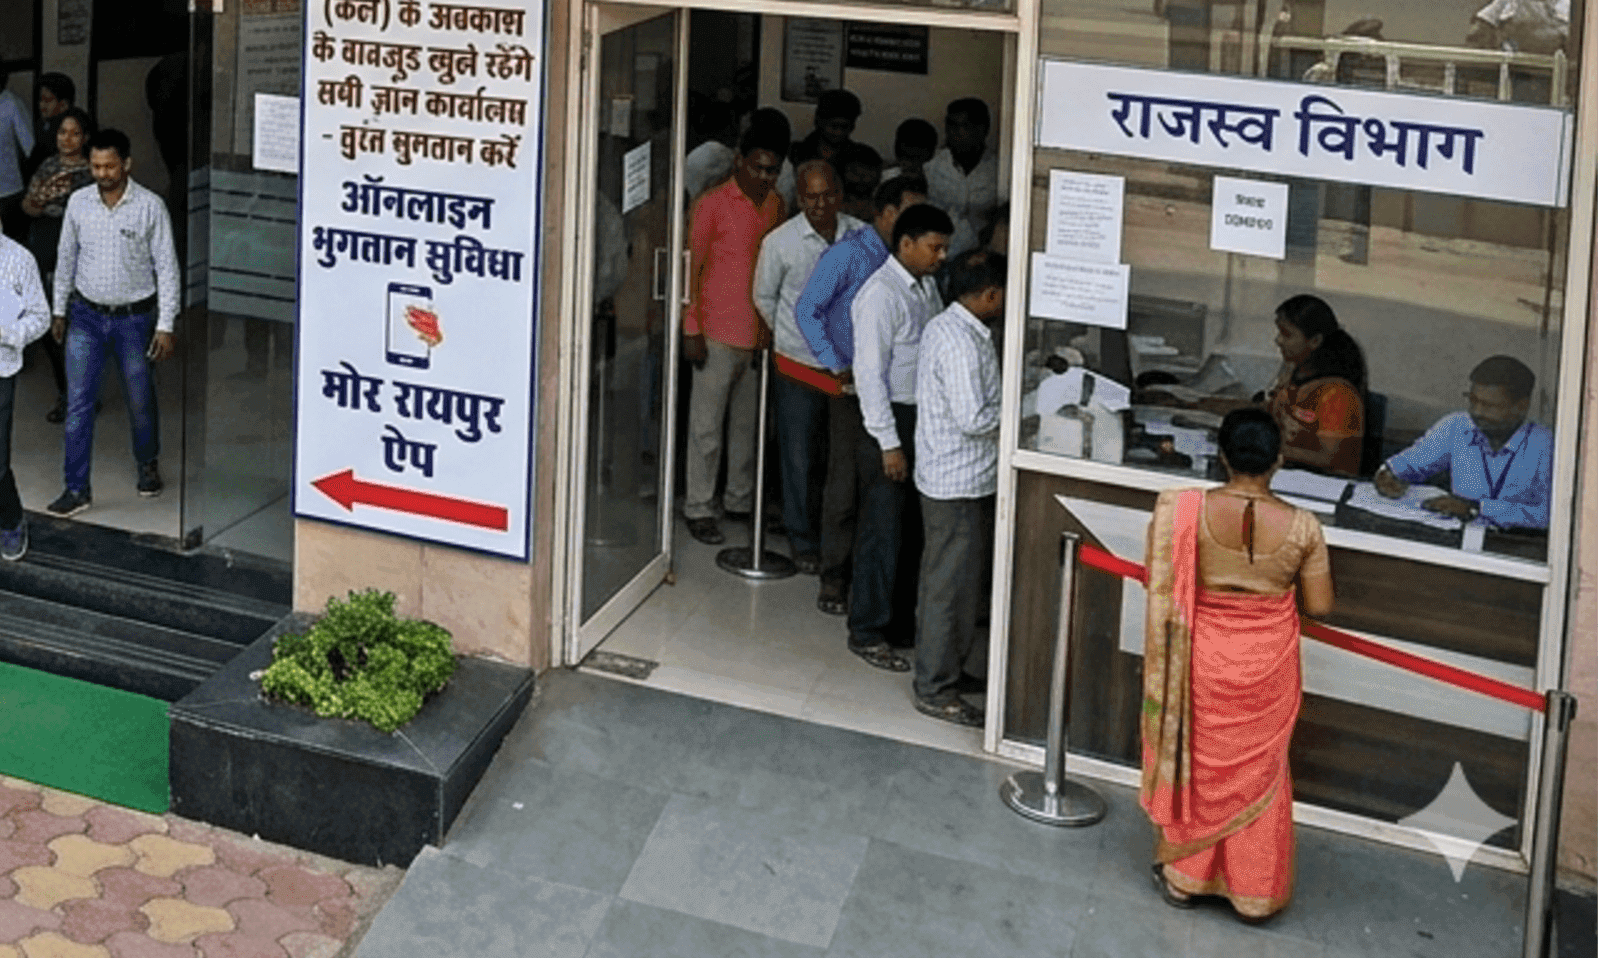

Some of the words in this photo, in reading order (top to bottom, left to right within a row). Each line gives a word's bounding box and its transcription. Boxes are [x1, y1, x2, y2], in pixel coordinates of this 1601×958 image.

[1106, 92, 1281, 152] राजस्व
[1294, 95, 1484, 175] विभाग
[341, 173, 495, 230] ऑनलाइन
[312, 226, 418, 269] भुगतान
[425, 234, 525, 285] सुविधा
[320, 360, 384, 413] मोर
[392, 380, 505, 442] रायपुर
